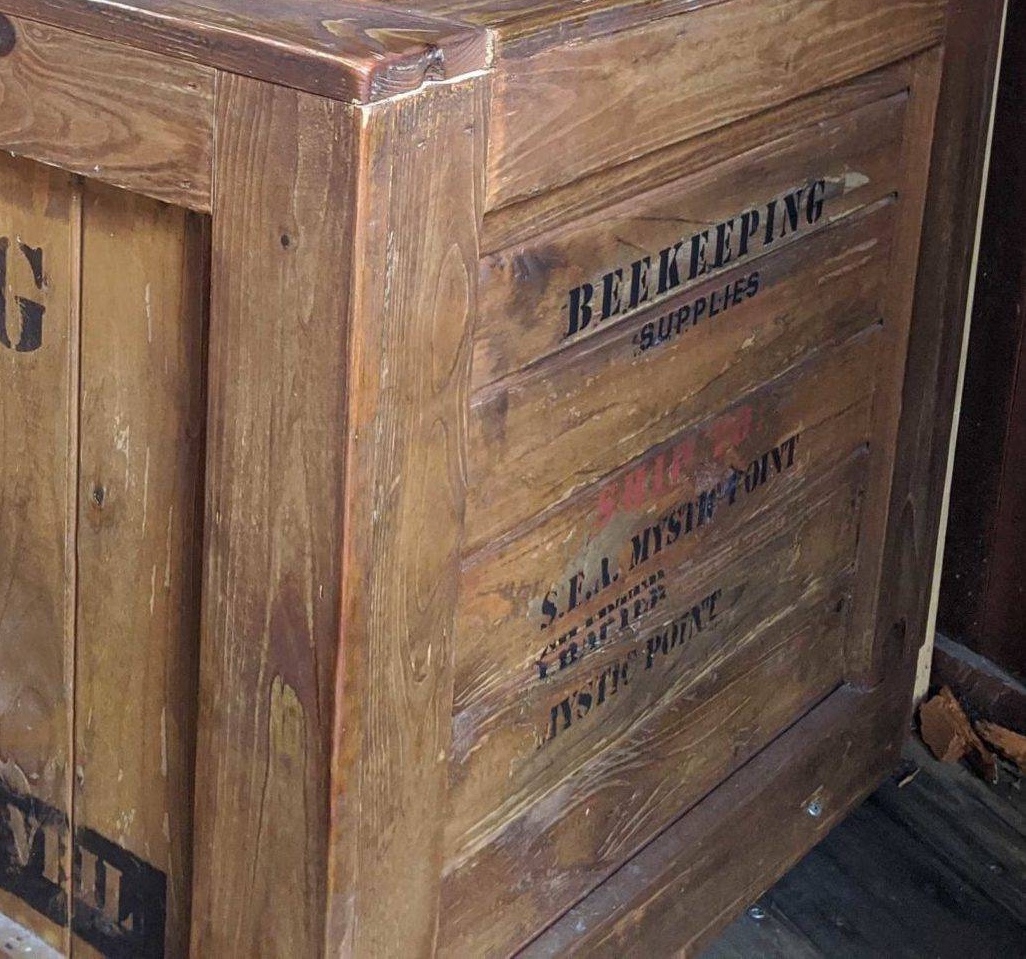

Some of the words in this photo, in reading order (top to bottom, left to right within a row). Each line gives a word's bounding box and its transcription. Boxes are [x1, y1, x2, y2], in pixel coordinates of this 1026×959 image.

[562, 179, 826, 339] BEEKEEPING
[636, 271, 761, 351] SUPPLIES
[726, 432, 801, 507] POINT
